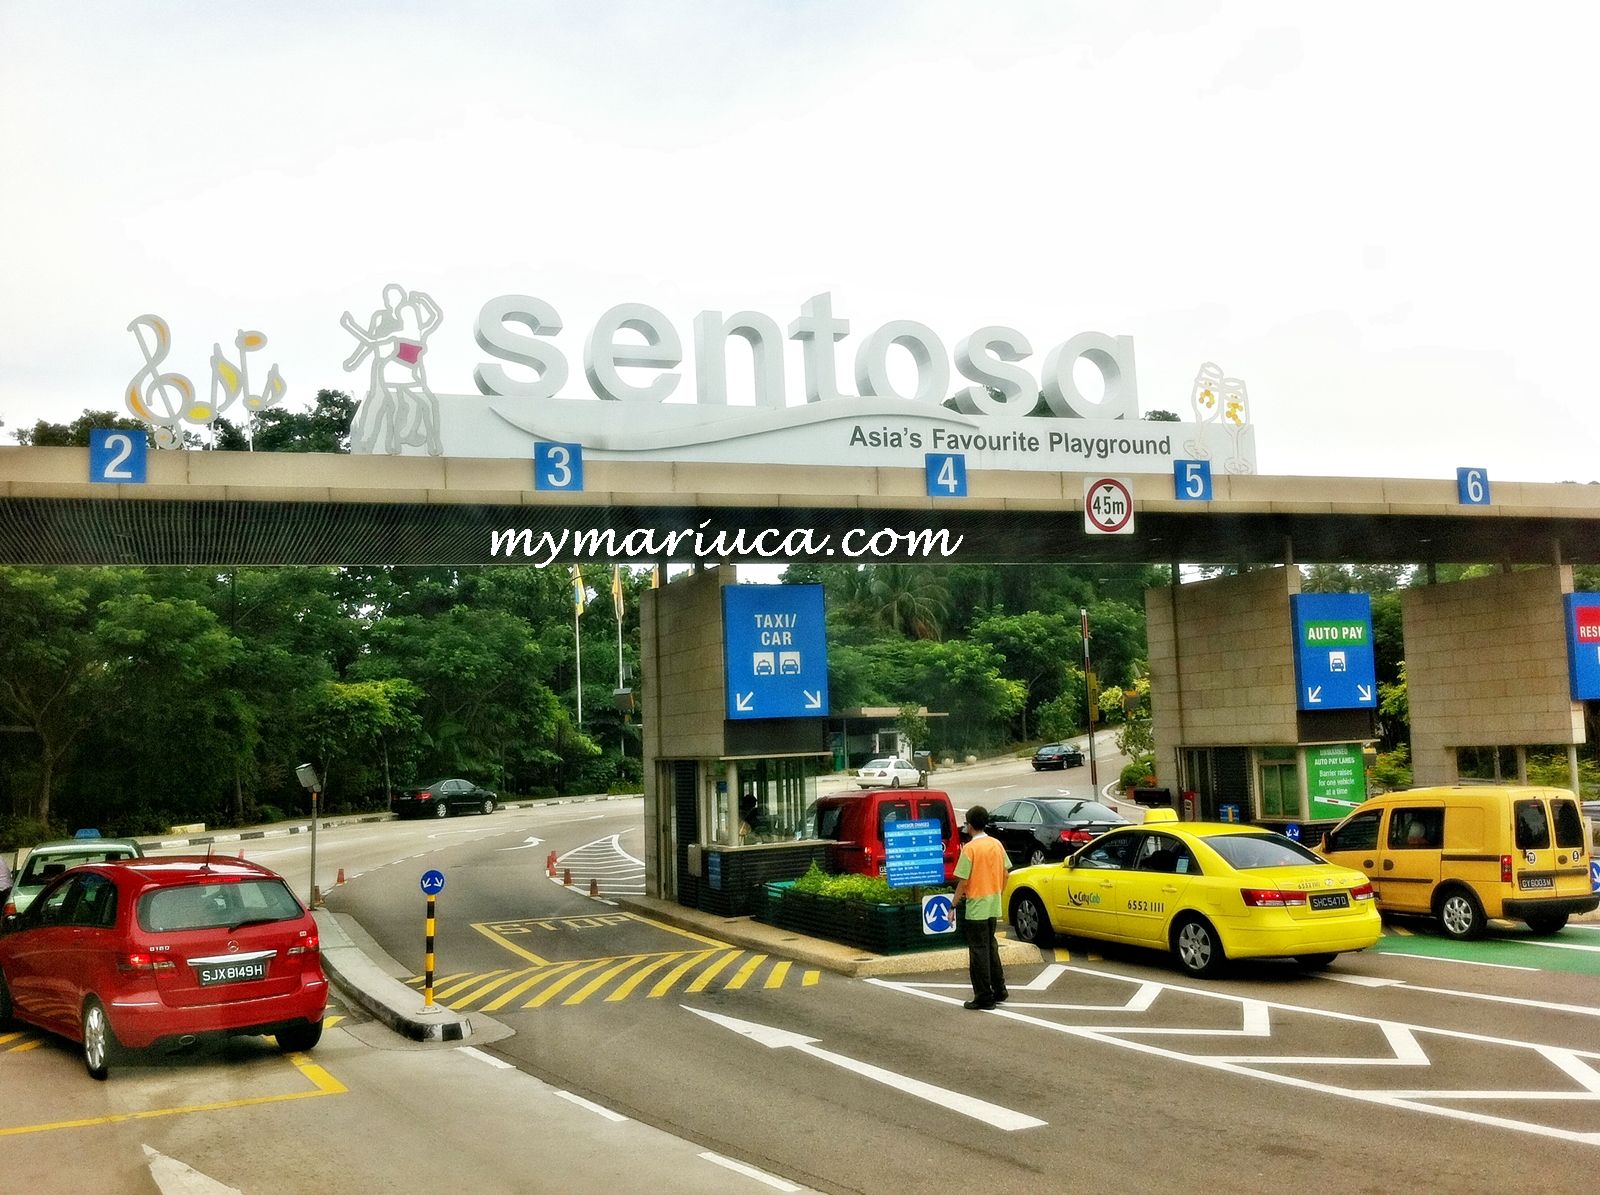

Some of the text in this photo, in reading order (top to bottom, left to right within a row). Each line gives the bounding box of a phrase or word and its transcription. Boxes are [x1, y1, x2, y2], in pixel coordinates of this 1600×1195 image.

[472, 291, 1139, 420] sentosa
[104, 434, 132, 478] 2
[849, 425, 1171, 459] Asia's Favourite Playground
[547, 446, 571, 487] 3
[937, 457, 958, 493] 4
[1186, 463, 1204, 498] 5
[1467, 470, 1483, 502] 6
[754, 613, 797, 628] TAXI/
[1308, 626, 1363, 640] AUTO PAY
[761, 631, 792, 646] CAR
[1314, 758, 1328, 766] AUTO
[1127, 900, 1147, 911] 6552
[490, 915, 631, 935] STOP
